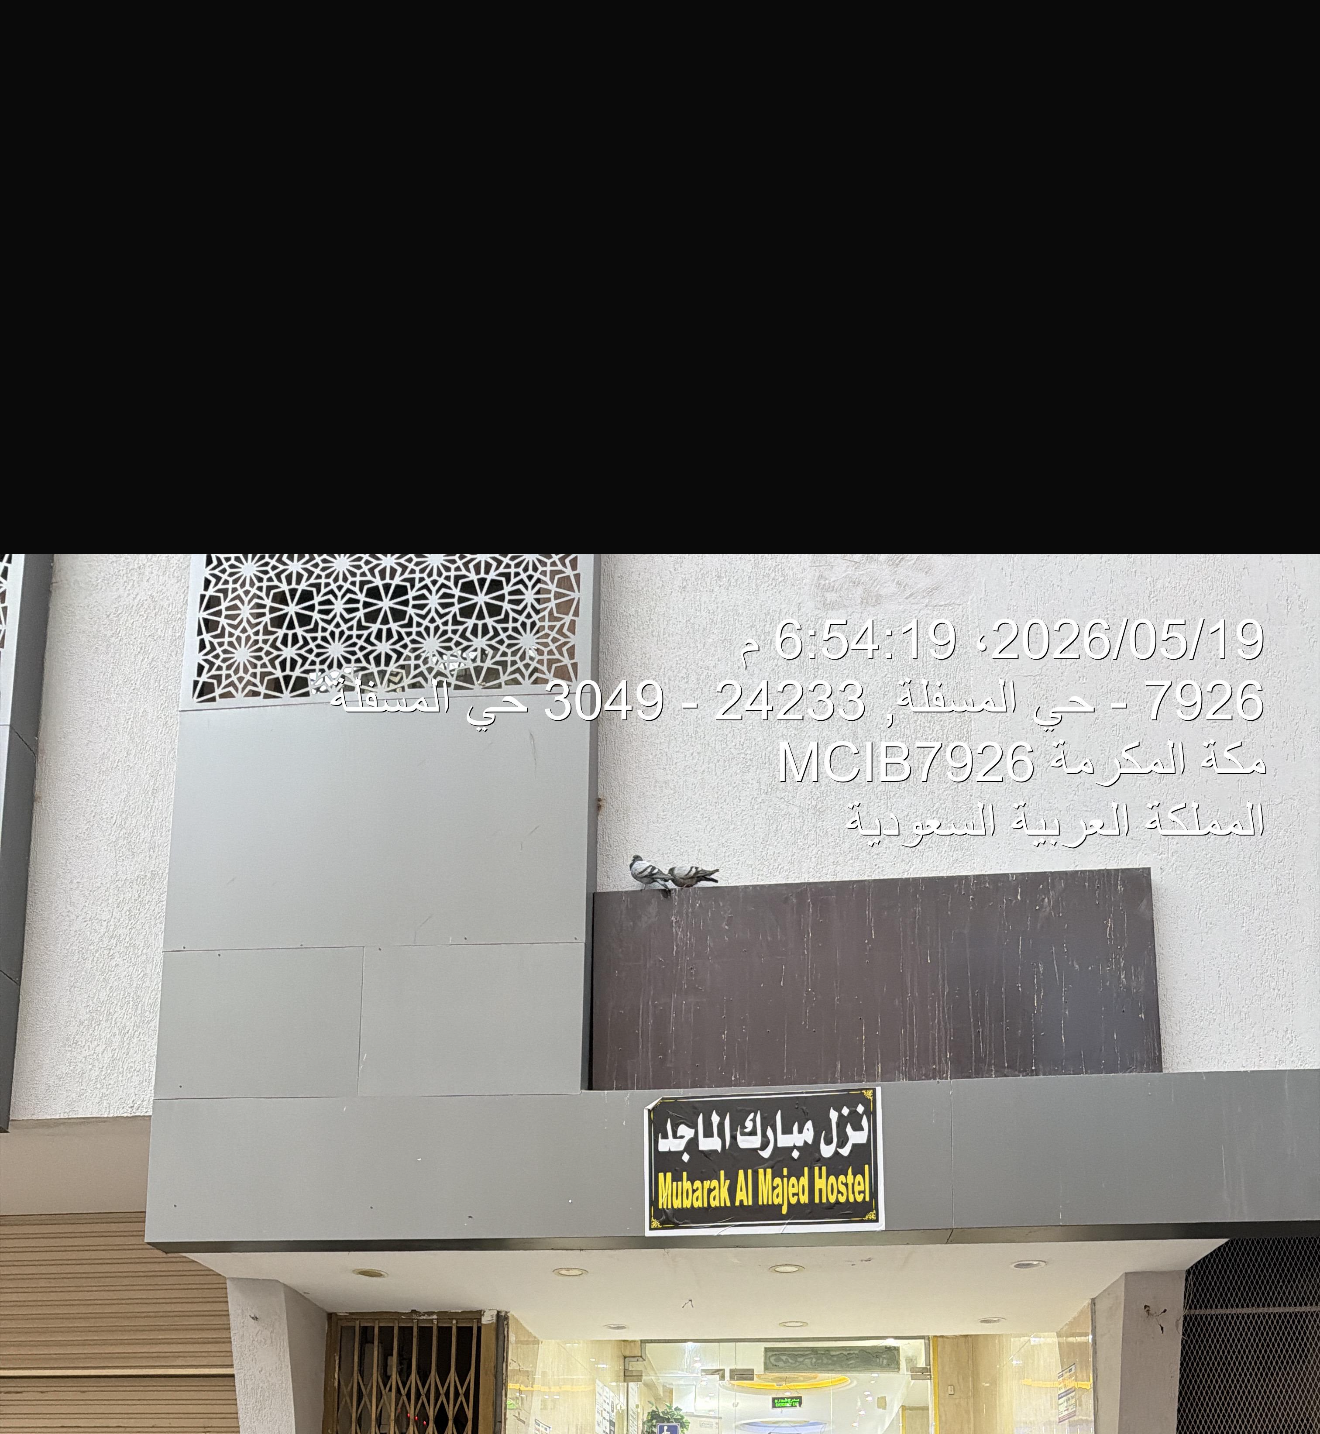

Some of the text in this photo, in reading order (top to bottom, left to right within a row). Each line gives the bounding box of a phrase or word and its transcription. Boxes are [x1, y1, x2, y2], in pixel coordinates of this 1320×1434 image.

[657, 1103, 870, 1163] نزل مبارك الماجد
[658, 1164, 870, 1215] Mubarak Al Majed Hostel
